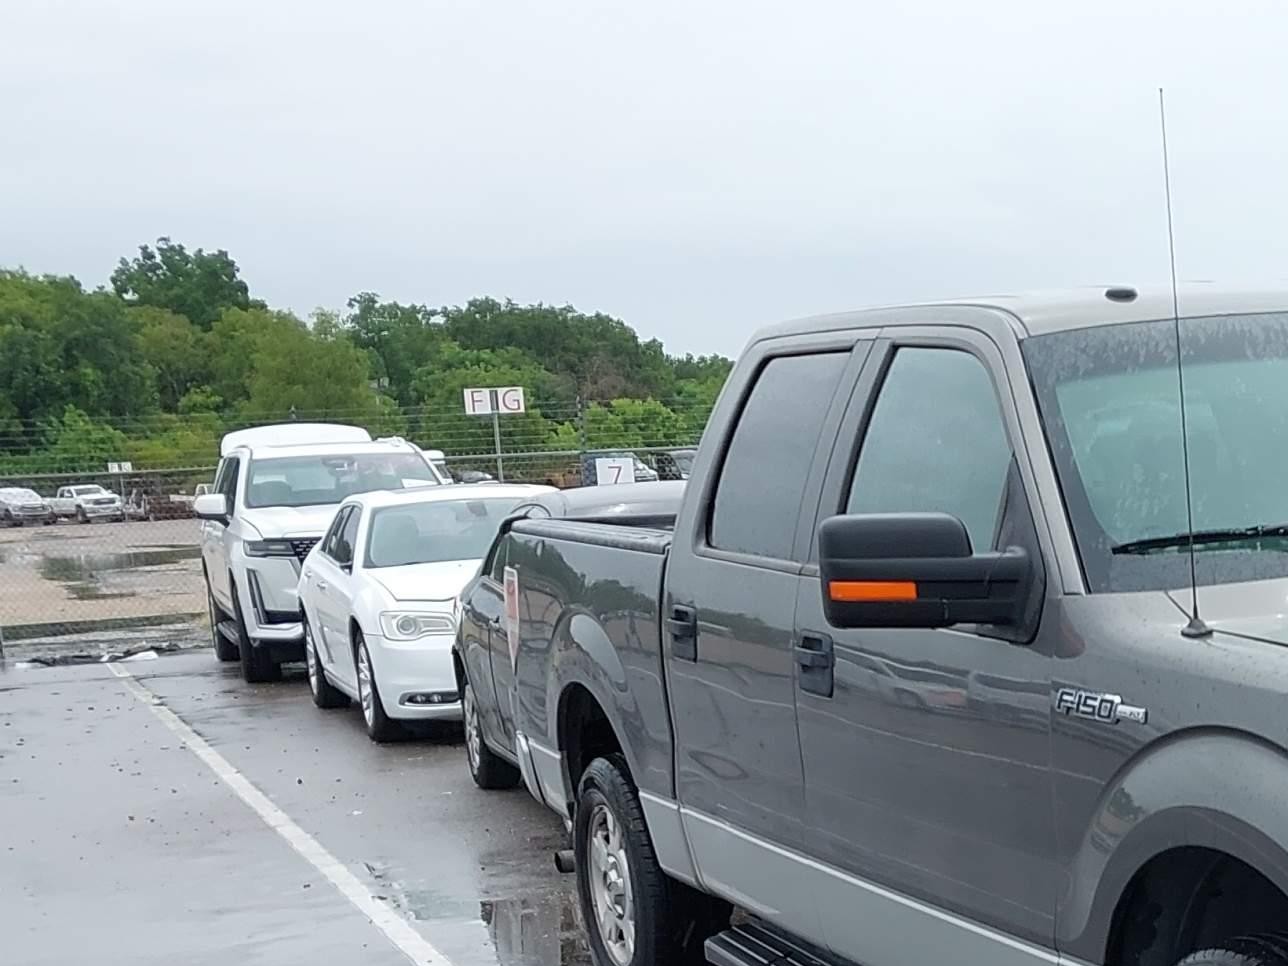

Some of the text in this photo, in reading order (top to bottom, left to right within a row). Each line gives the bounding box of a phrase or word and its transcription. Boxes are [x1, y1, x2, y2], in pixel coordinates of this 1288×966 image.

[470, 388, 522, 413] F G
[607, 465, 623, 484] 7
